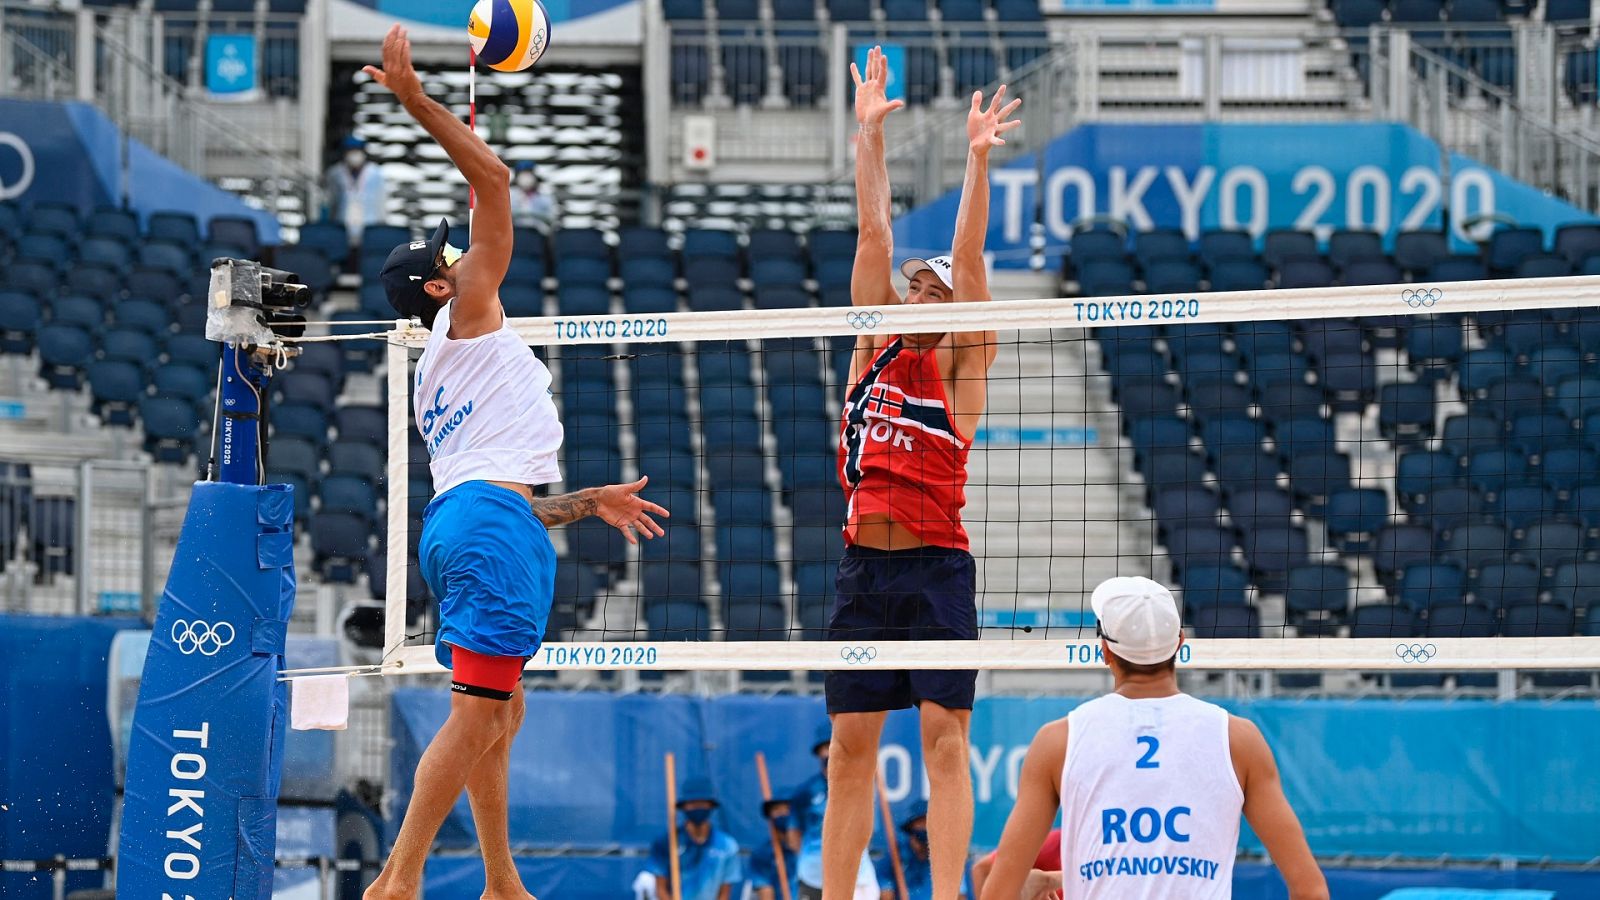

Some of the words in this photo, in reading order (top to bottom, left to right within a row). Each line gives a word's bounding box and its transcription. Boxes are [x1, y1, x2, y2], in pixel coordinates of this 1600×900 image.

[992, 165, 1269, 243] TOKYO
[1290, 165, 1497, 243] 2020
[929, 258, 951, 270] OR
[1073, 301, 1142, 321] TOKYO
[1148, 299, 1199, 319] 2020
[554, 320, 616, 339] TOKYO
[622, 318, 667, 337] 2020
[544, 647, 606, 665] TOKYO
[610, 647, 657, 665] 2020
[1065, 644, 1104, 663] TOK
[1136, 735, 1160, 769] 2
[164, 722, 209, 880] TOKYO
[1102, 806, 1191, 845] ROC
